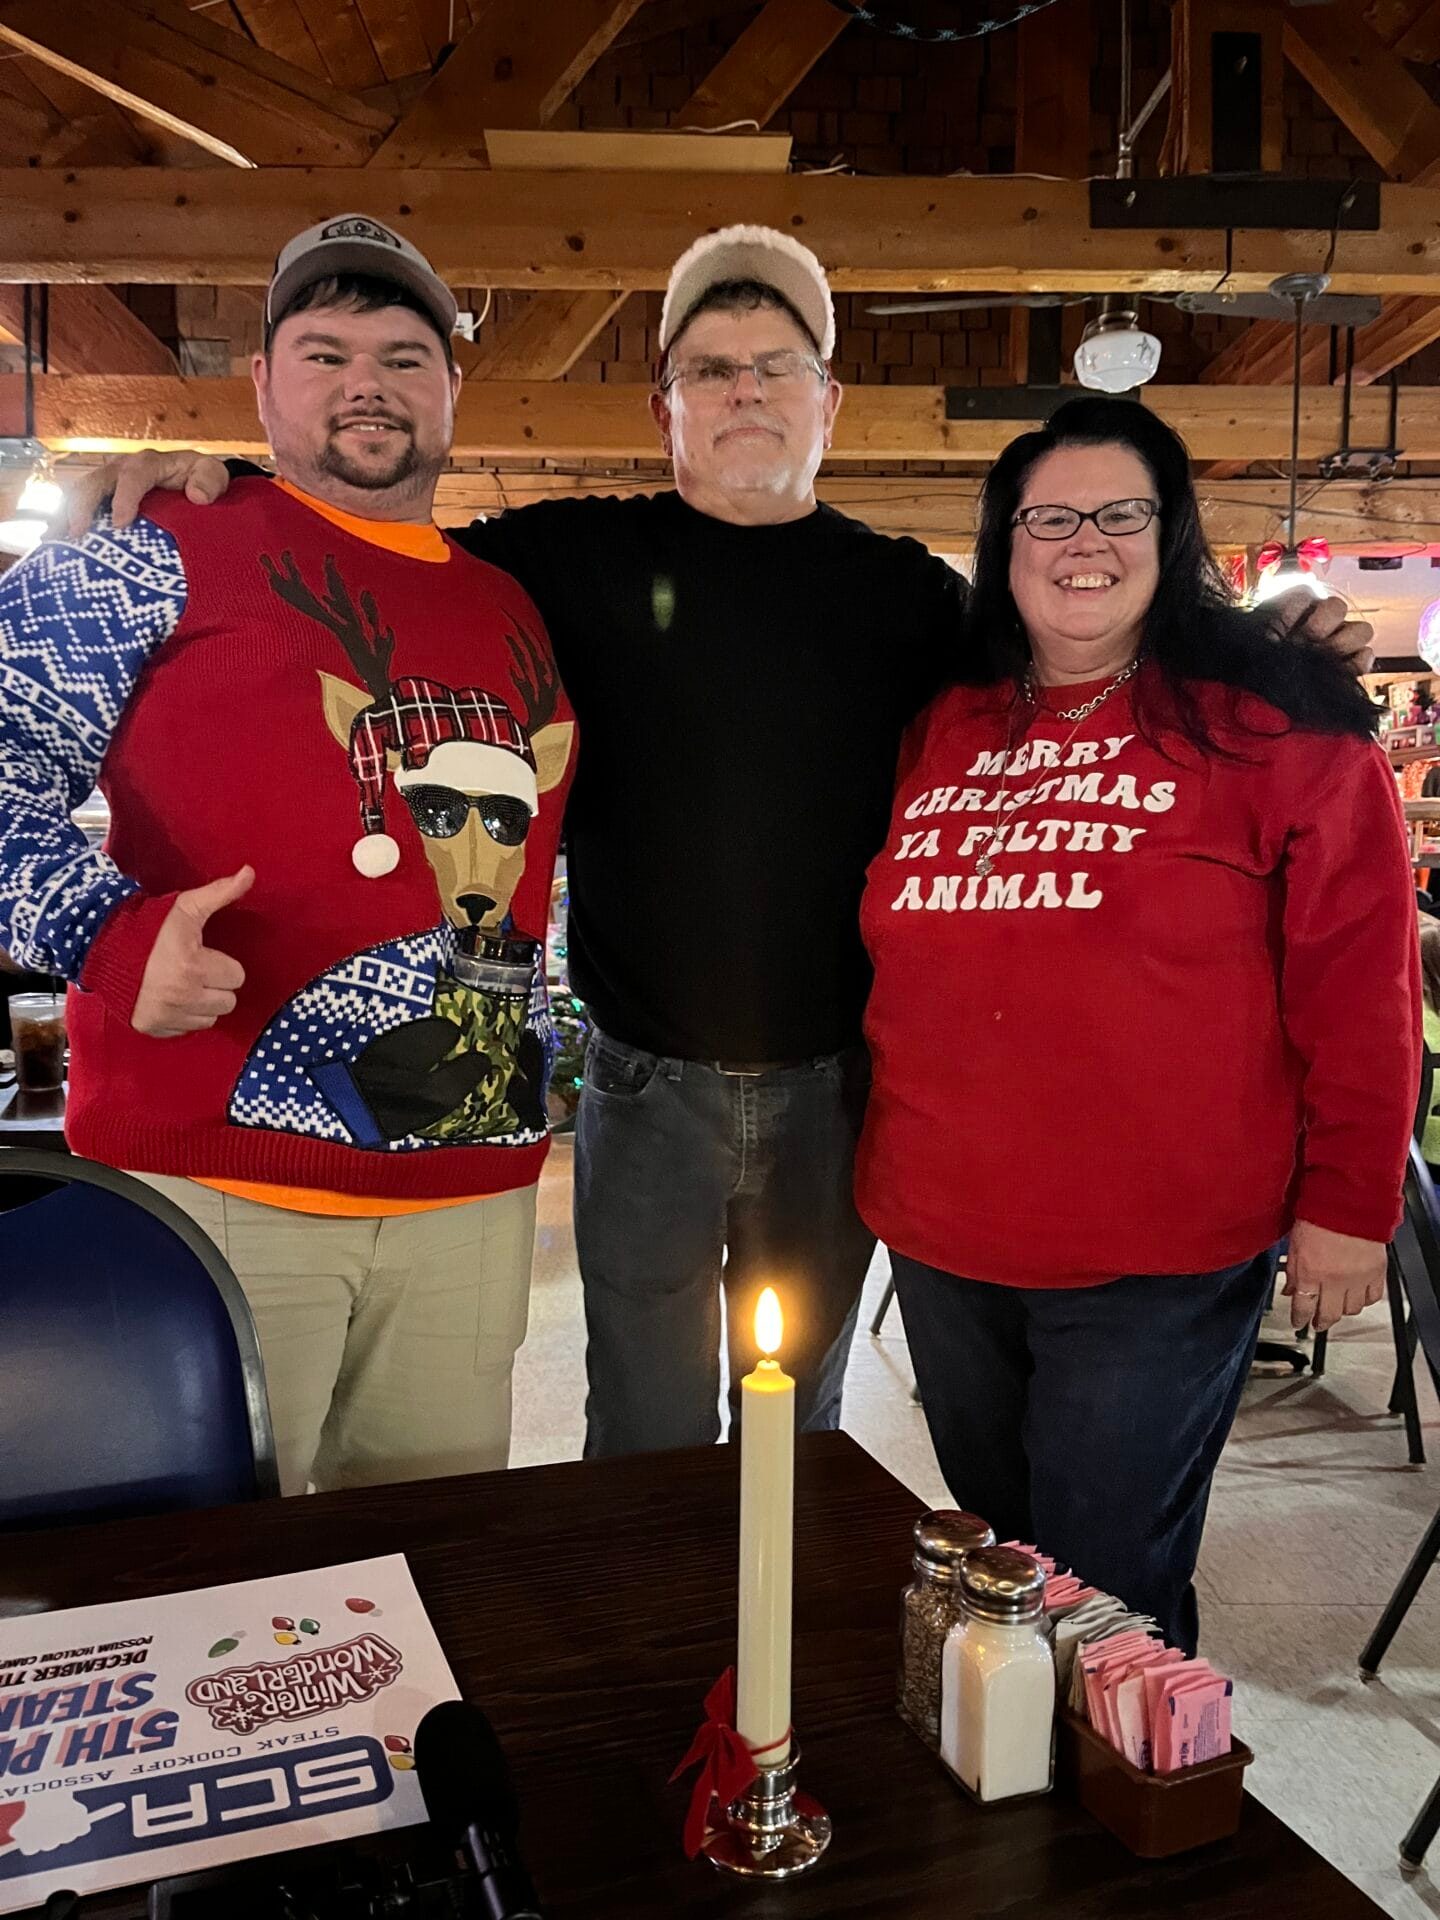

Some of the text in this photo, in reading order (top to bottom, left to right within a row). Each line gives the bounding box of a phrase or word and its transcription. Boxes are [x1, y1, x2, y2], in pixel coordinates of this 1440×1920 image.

[966, 734, 1135, 776] MERRY
[904, 772, 1177, 820] CHRISTMAS
[894, 819, 1147, 860] YA FILTHY
[891, 872, 1103, 913] ANIMAL
[0, 1635, 153, 1670] POSSUM HOLLOW CAMP
[33, 1649, 148, 1682] DECEMBER
[60, 1710, 179, 1768] 5TH
[0, 1726, 340, 1799] STEAK COOKOFF ASSOCIA
[131, 1749, 378, 1839] SCA
